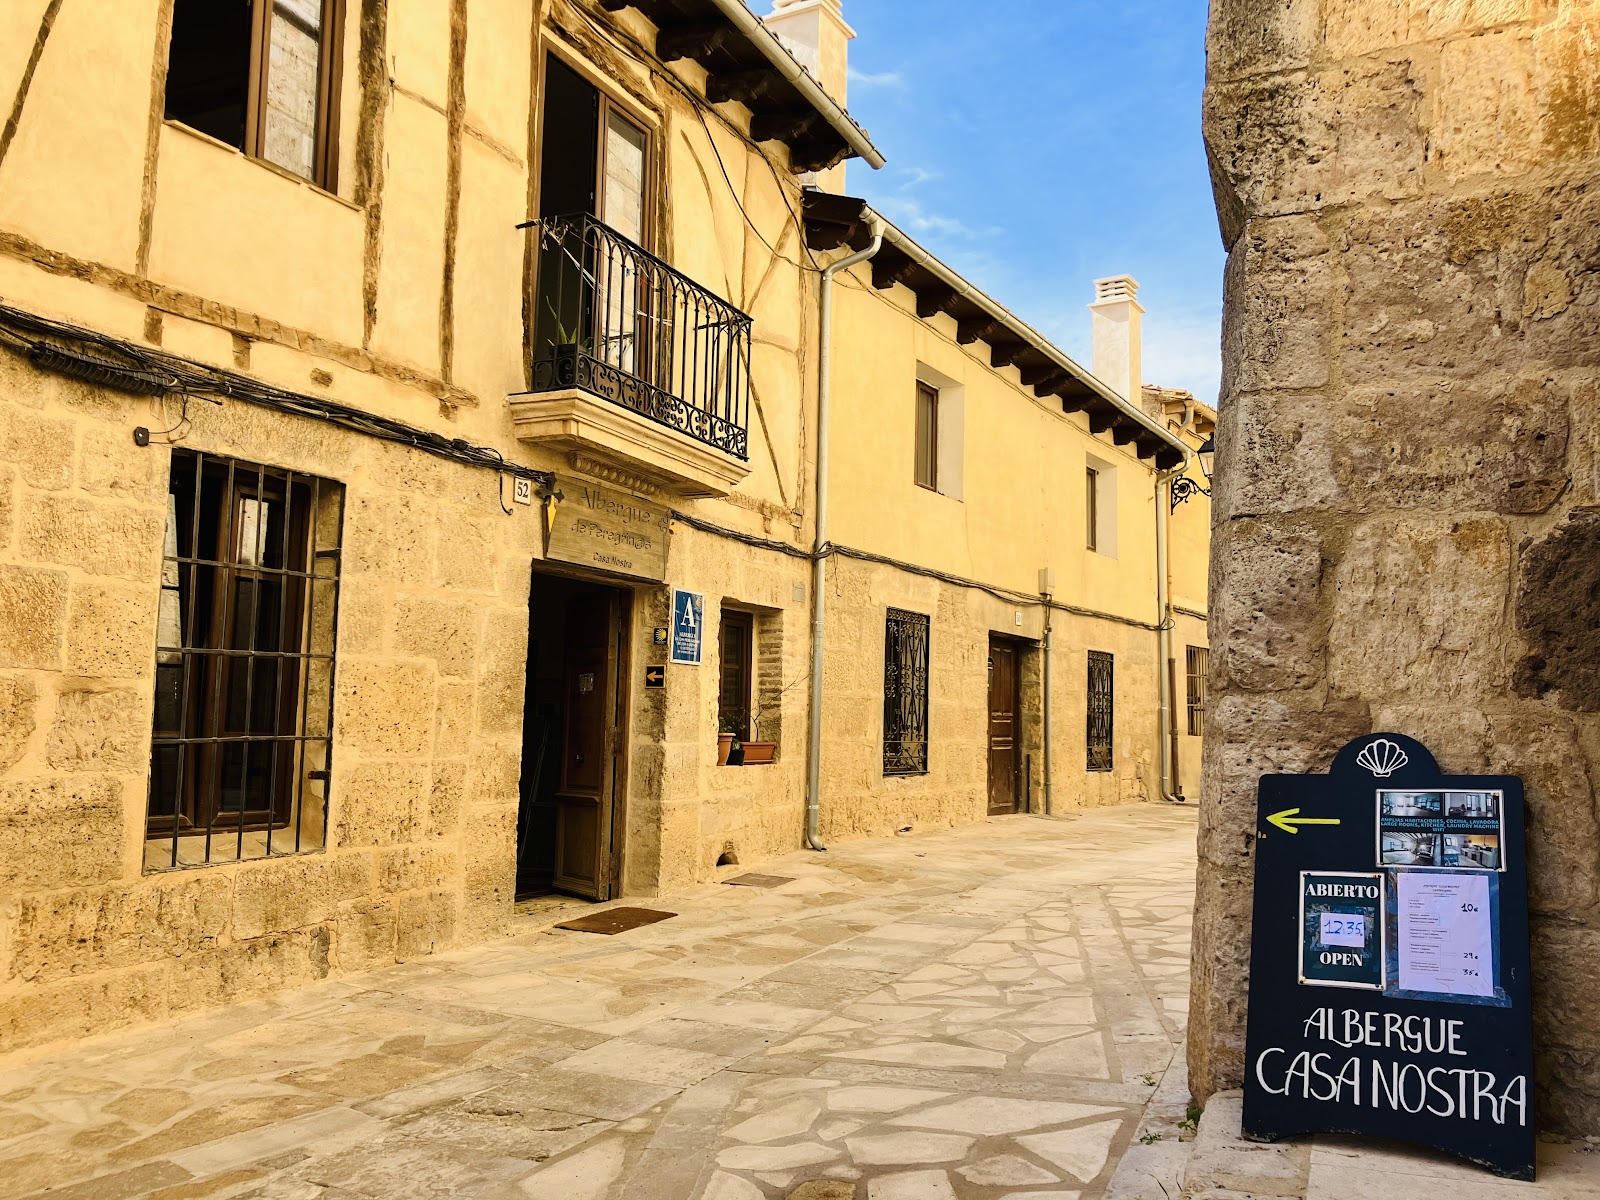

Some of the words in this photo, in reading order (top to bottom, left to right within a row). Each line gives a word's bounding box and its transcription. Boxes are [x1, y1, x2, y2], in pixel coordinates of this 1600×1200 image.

[517, 481, 529, 498] 52
[579, 487, 651, 524] Albergue
[571, 519, 587, 534] de
[593, 552, 610, 564] Casa
[610, 556, 633, 569] Nostra
[680, 597, 696, 628] A
[1305, 883, 1379, 899] ABIERTO
[1320, 952, 1363, 967] OPEN
[1303, 1007, 1468, 1056] ALBERGUE
[1256, 1047, 1361, 1106] CASA
[1372, 1059, 1526, 1127] NOSTRA
